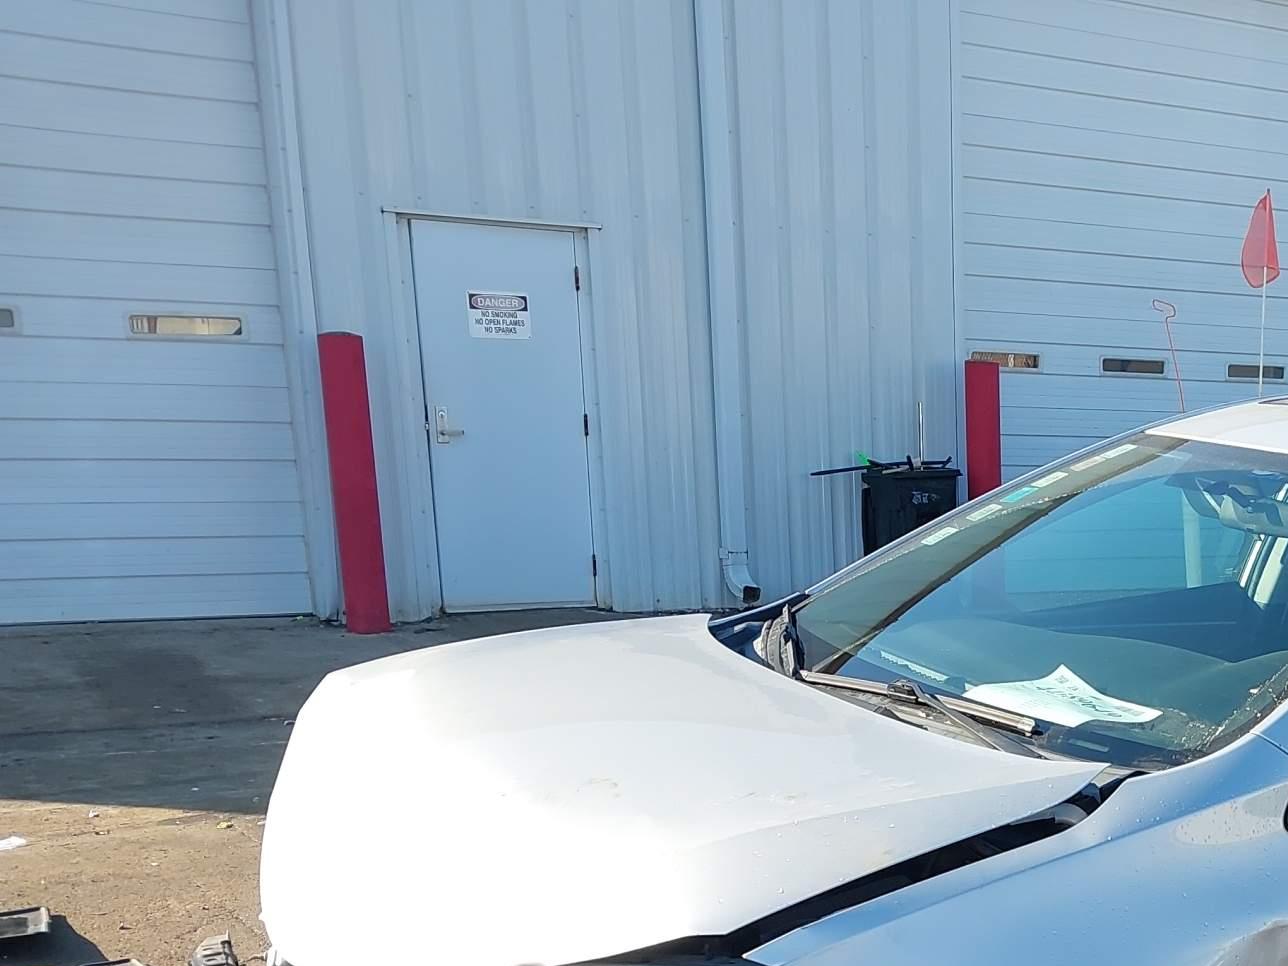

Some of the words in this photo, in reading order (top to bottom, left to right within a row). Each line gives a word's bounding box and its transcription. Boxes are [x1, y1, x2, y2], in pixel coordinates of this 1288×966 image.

[477, 297, 519, 307] DANGER
[485, 318, 501, 326] OPEN
[502, 319, 525, 327] FLAMES
